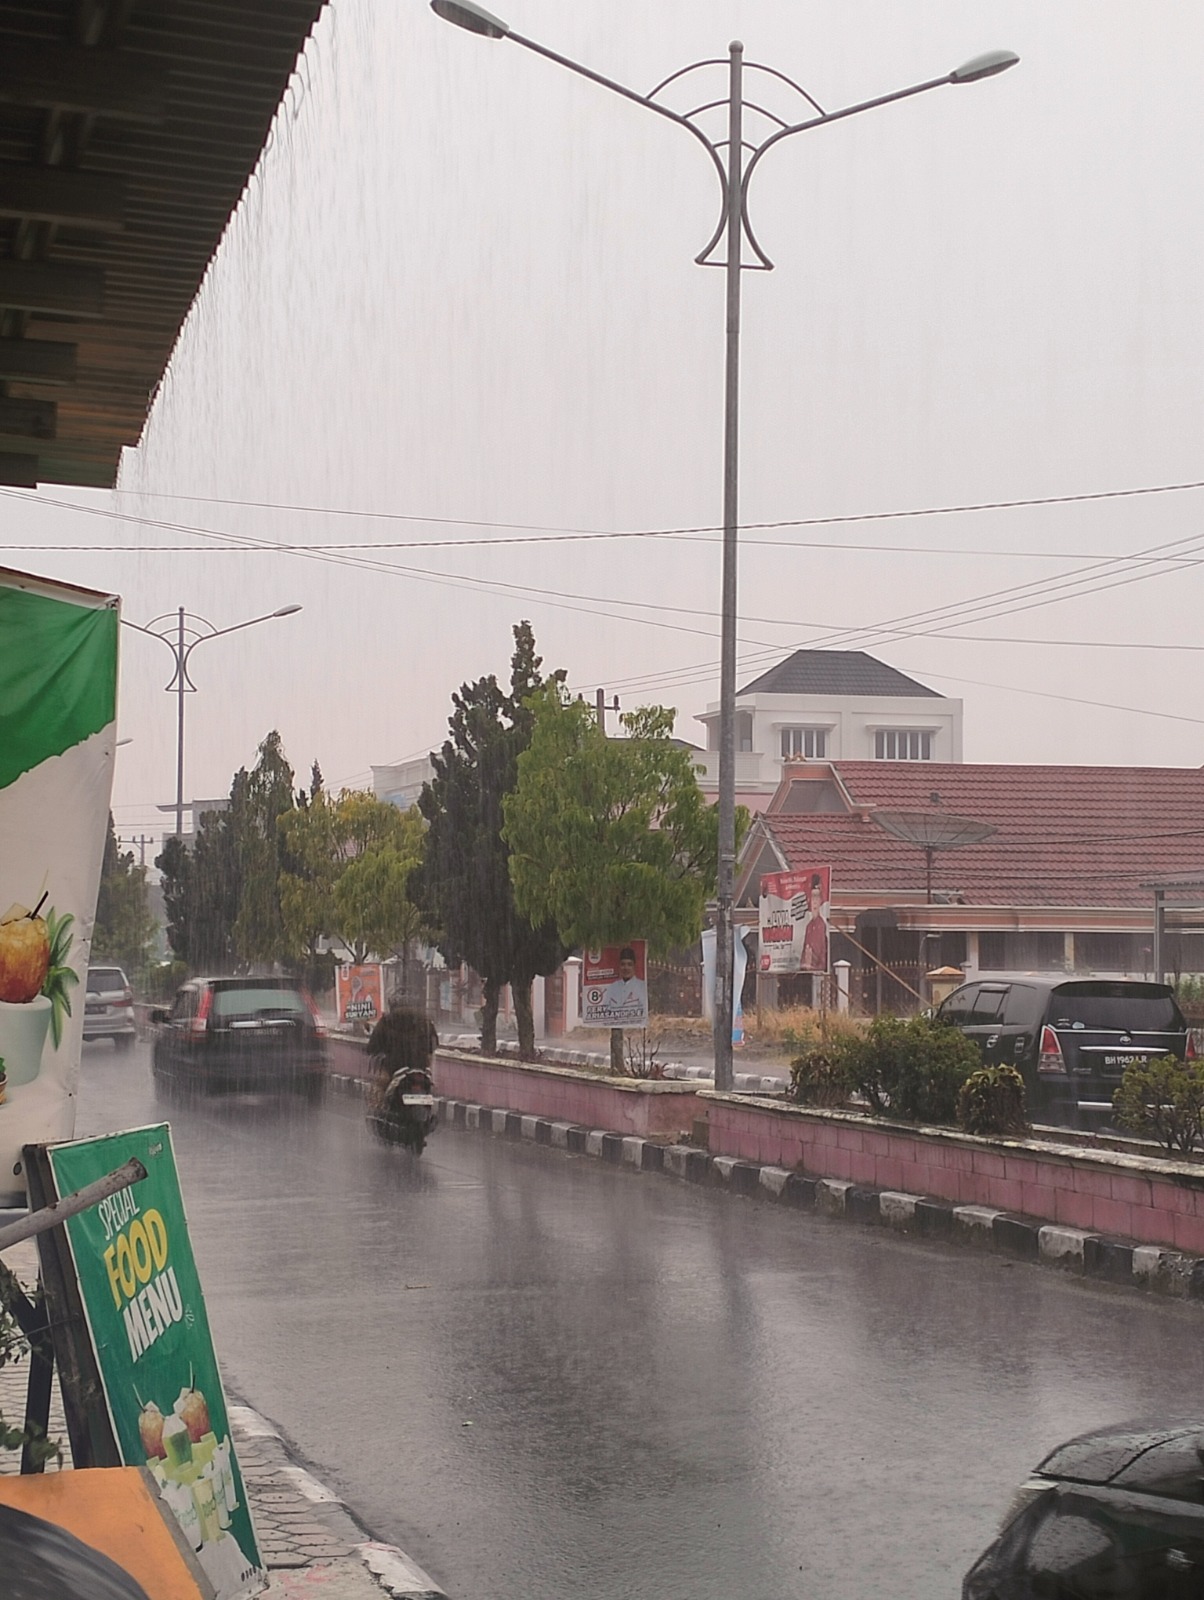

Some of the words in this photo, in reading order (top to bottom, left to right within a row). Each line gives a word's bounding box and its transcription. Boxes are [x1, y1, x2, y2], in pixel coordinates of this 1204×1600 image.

[592, 991, 599, 1002] 8
[1105, 1056, 1116, 1064] BH
[1117, 1055, 1134, 1064] 1962
[98, 1186, 140, 1241] SPECIAL
[103, 1208, 168, 1312] FOOD
[123, 1266, 183, 1364] MENU
